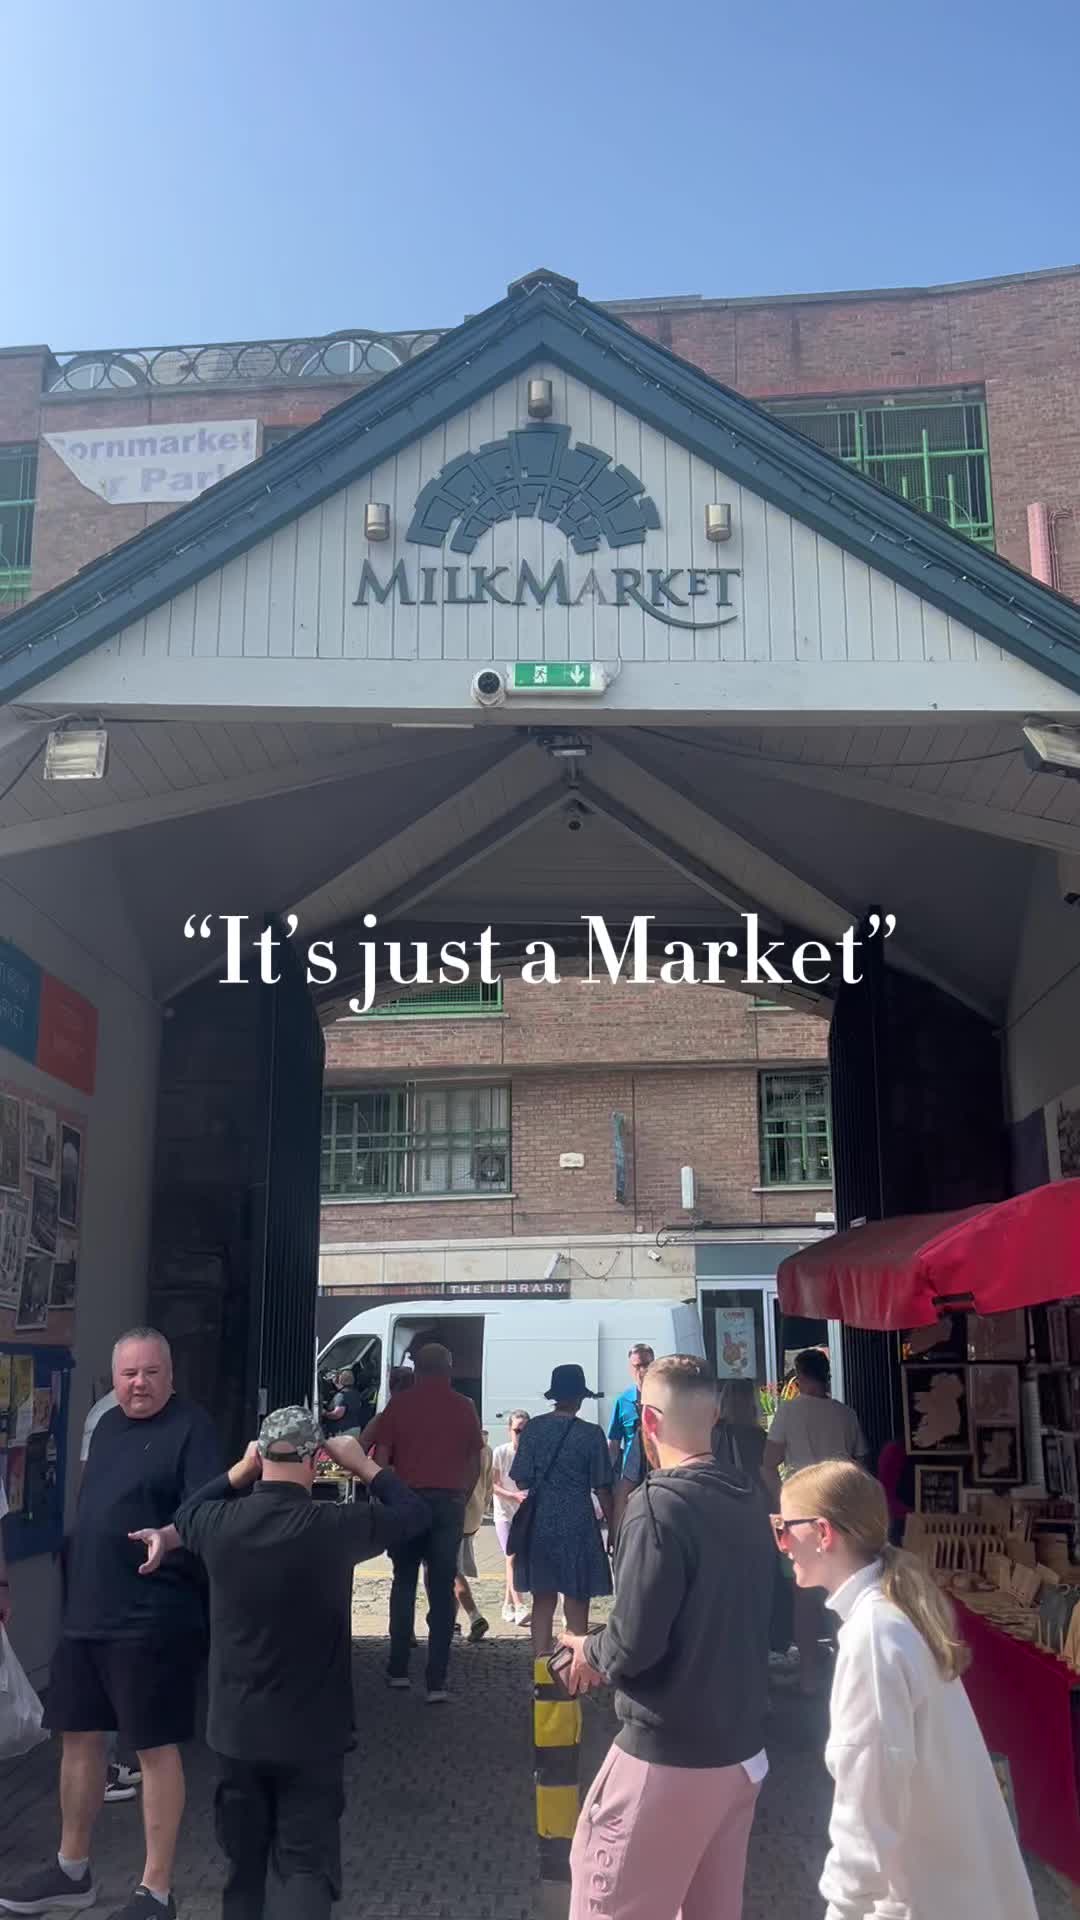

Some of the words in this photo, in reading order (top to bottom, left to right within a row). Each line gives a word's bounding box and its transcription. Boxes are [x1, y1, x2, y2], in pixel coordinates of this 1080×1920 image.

[58, 427, 252, 461] ornmarket
[450, 1284, 483, 1295] THE
[489, 1282, 568, 1294] LIBRARY
